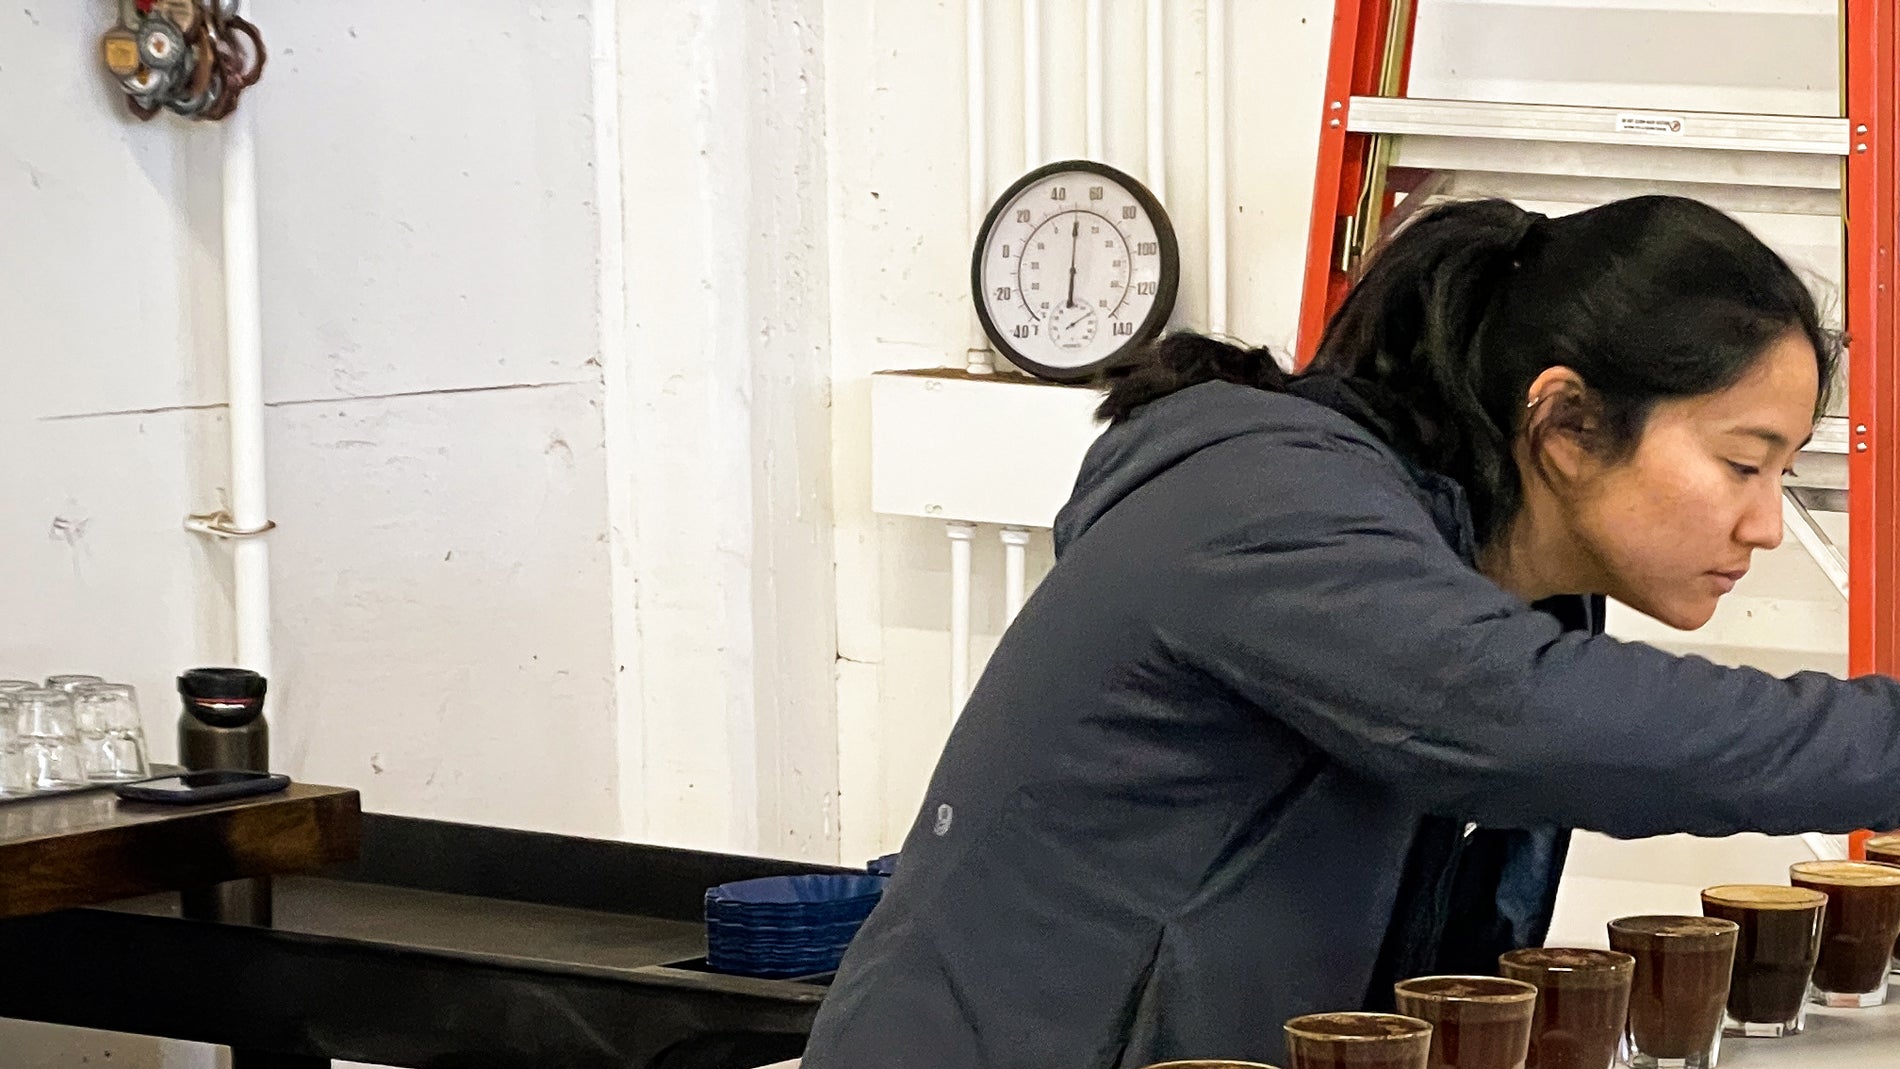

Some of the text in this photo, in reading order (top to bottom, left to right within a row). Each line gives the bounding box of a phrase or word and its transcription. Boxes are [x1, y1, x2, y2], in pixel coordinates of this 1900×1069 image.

[1051, 187, 1066, 201] 40
[1089, 187, 1104, 201] 60
[1016, 210, 1031, 223] 20
[1122, 206, 1137, 219] 80
[1002, 245, 1010, 259] 0
[1138, 243, 1157, 256] 100
[1137, 282, 1156, 296] 120
[1113, 322, 1133, 337] 140
